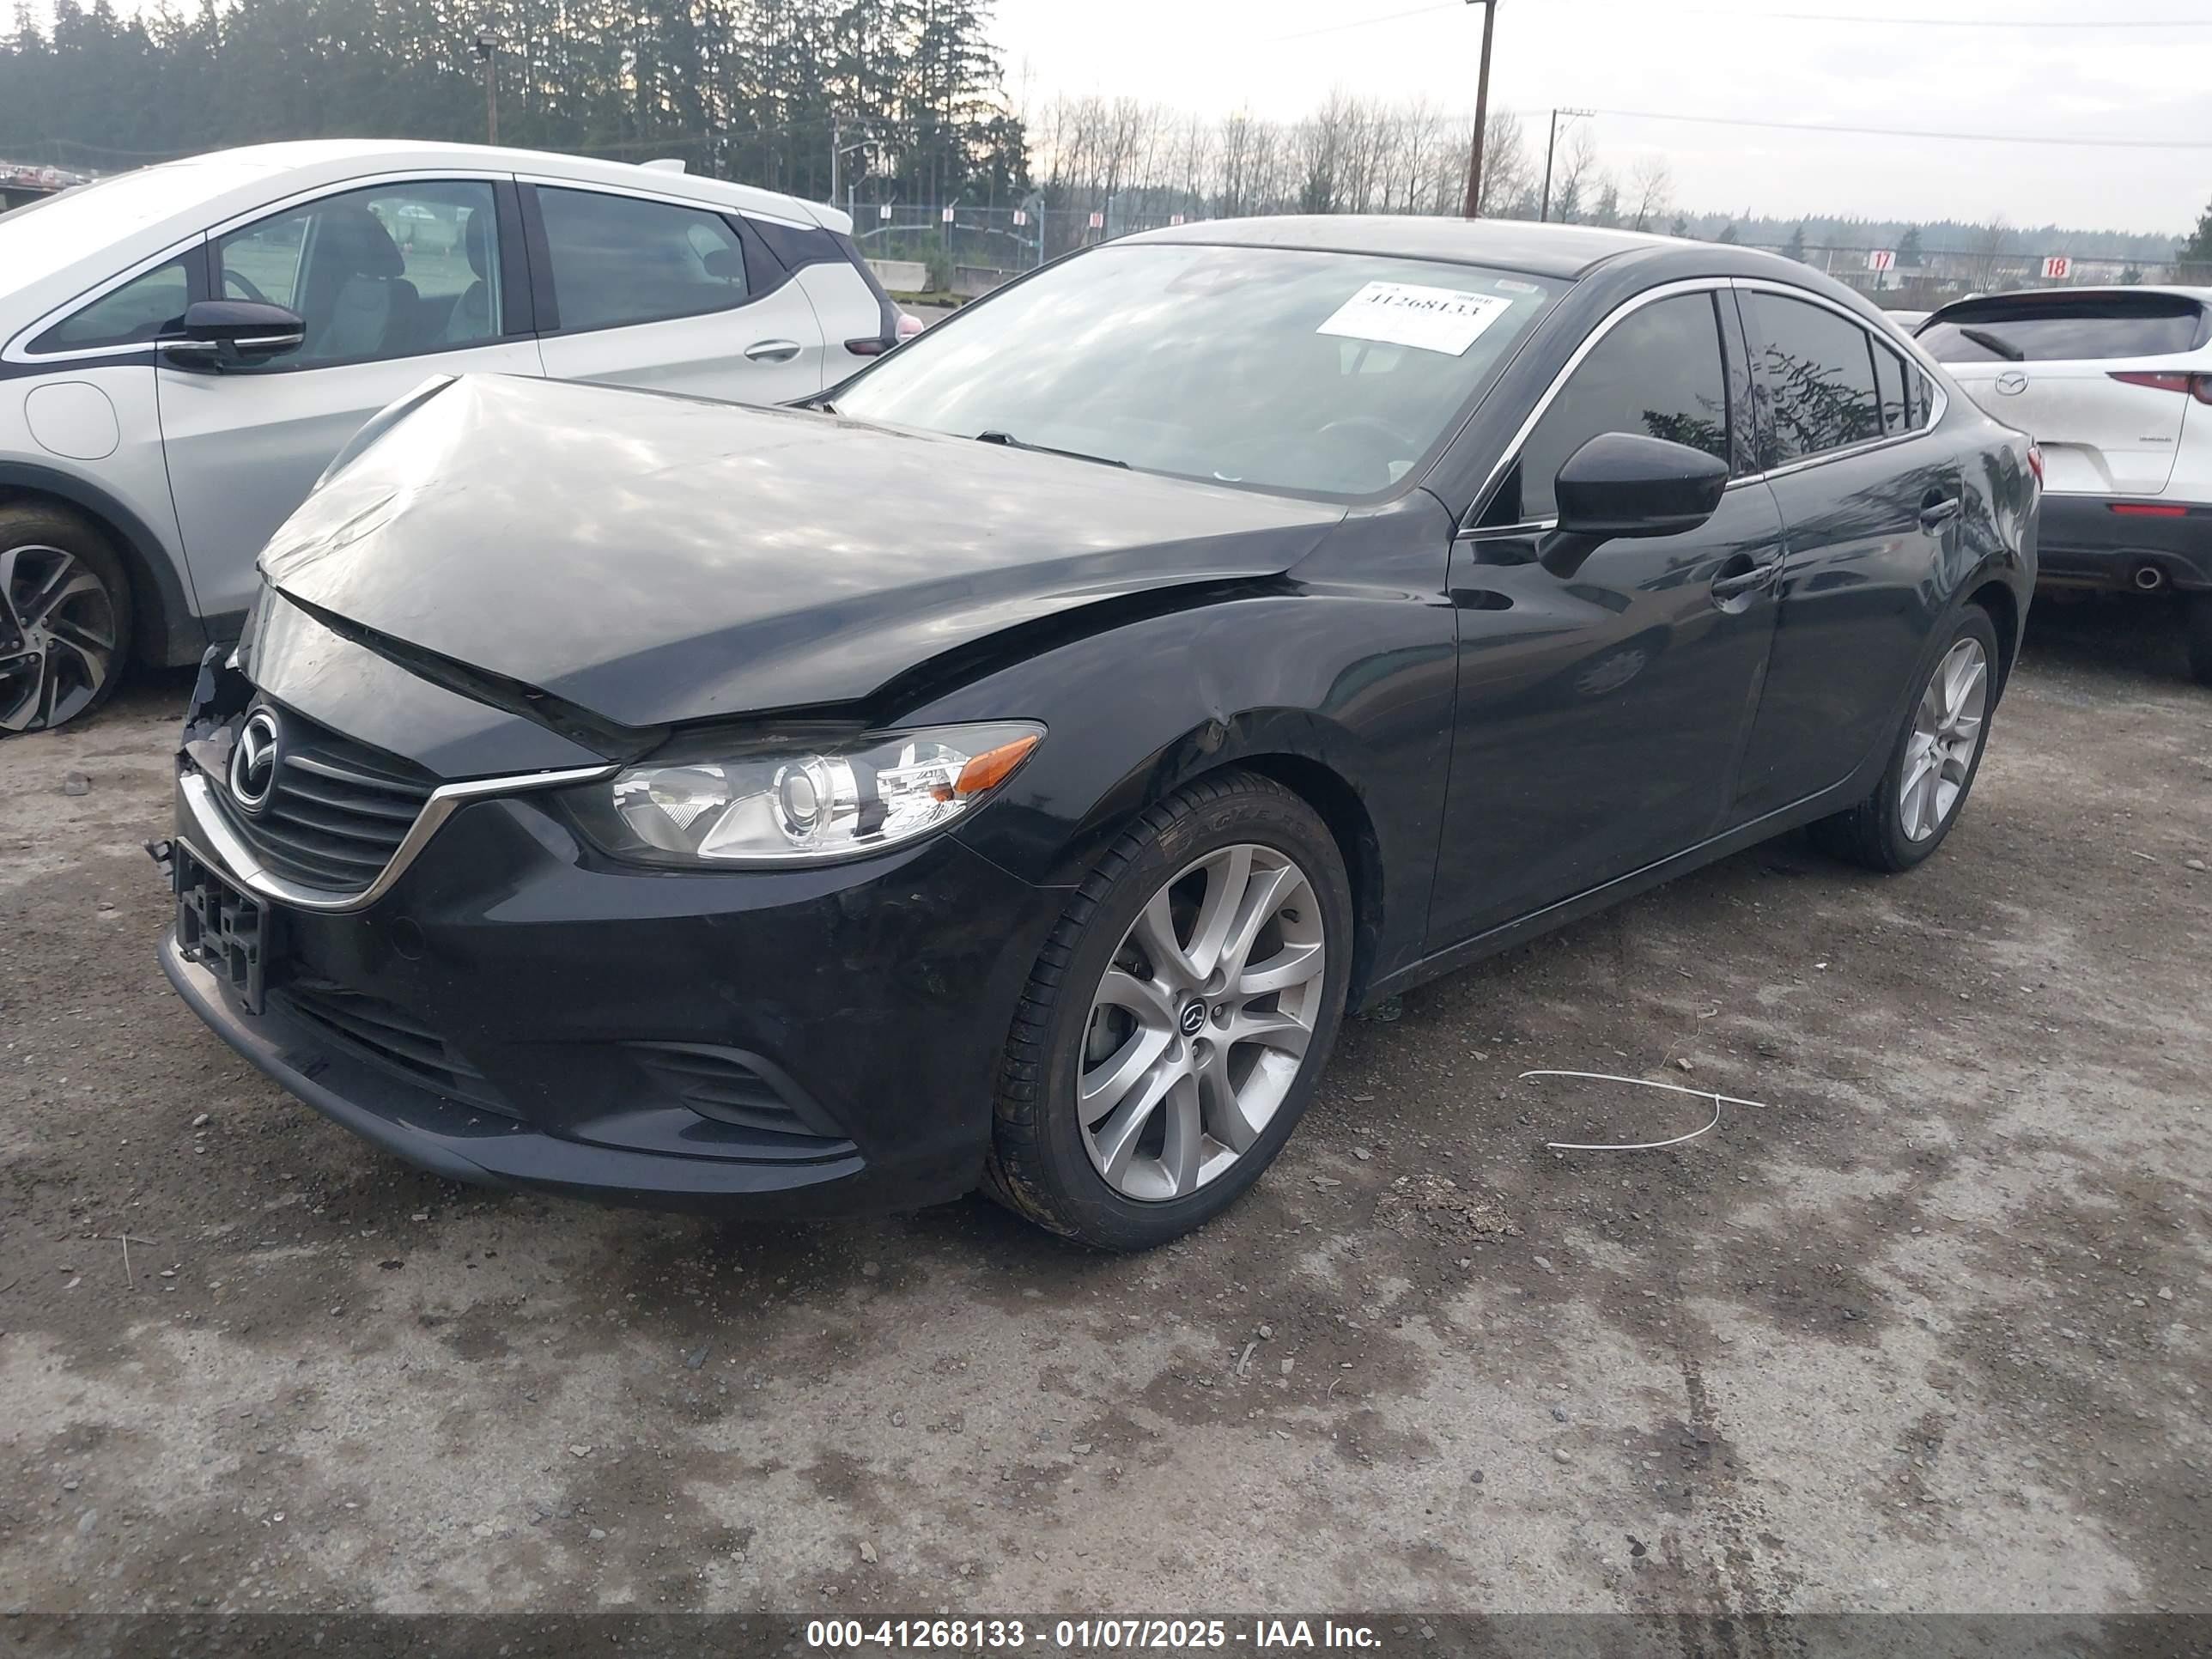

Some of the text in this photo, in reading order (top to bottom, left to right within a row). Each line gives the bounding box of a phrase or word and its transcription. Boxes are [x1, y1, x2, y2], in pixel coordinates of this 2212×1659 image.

[1875, 252, 1890, 268] 17
[2047, 260, 2066, 276] 18
[1367, 294, 1480, 316] 41268133
